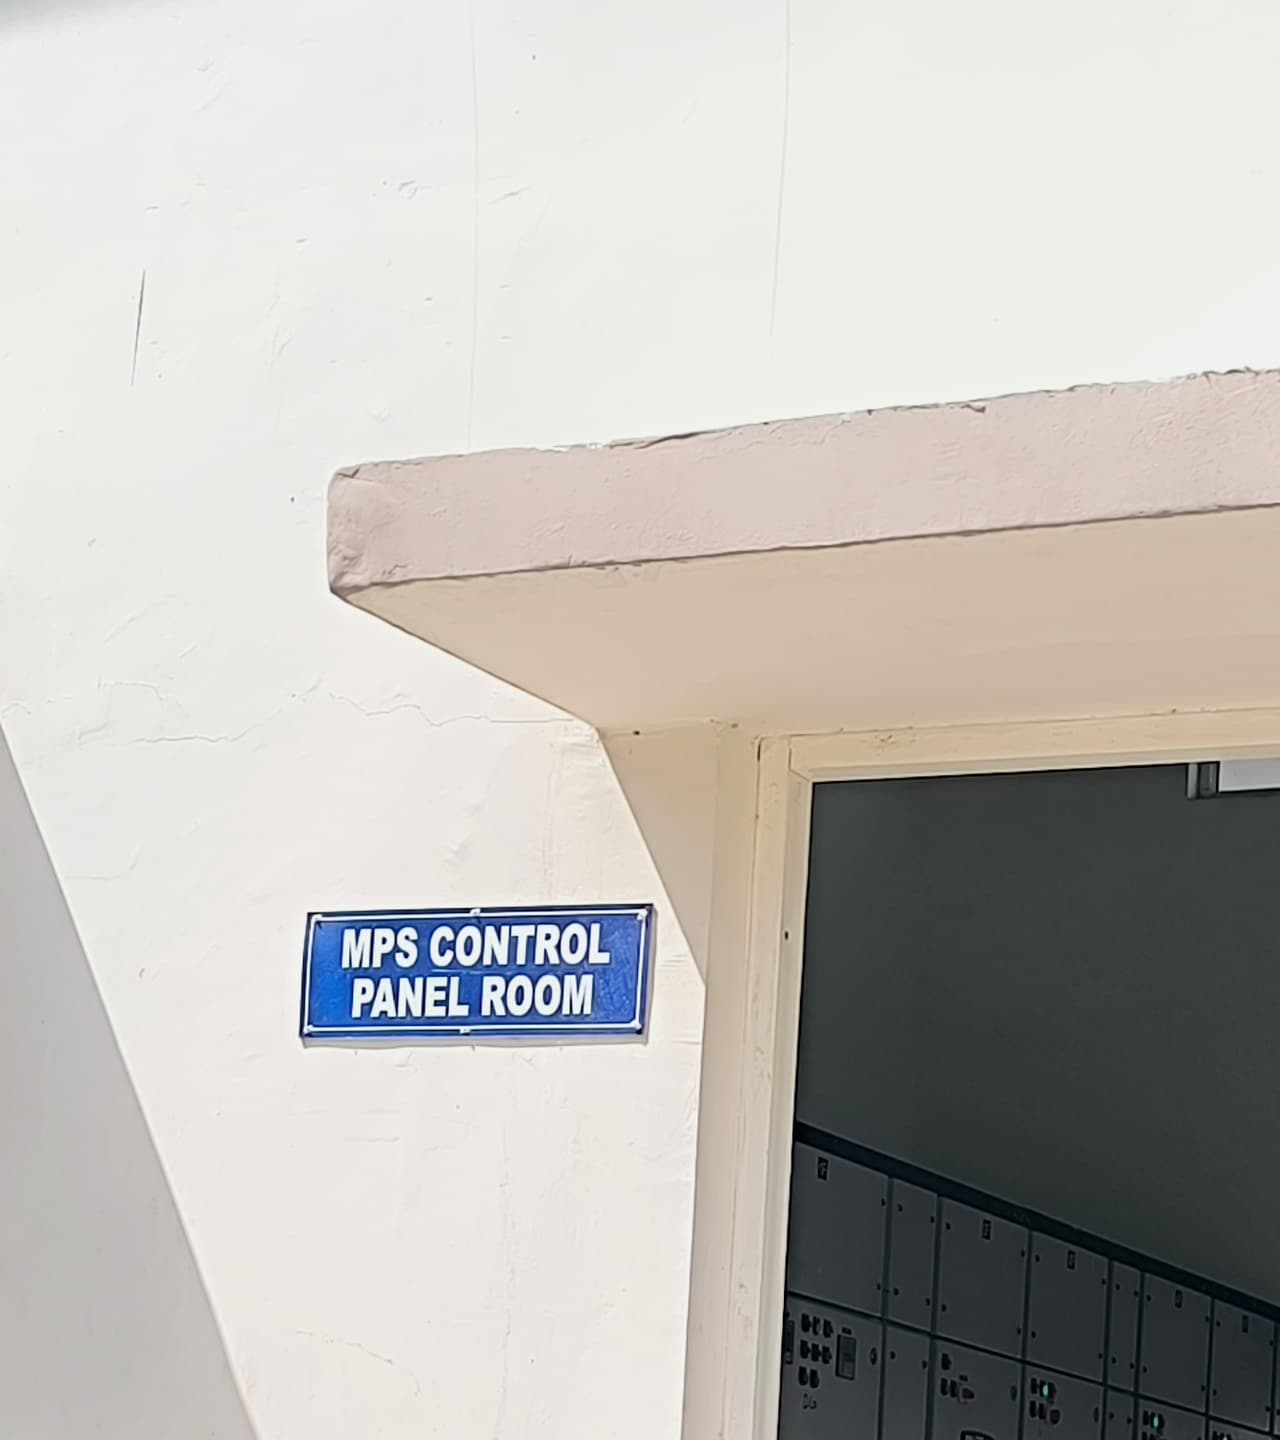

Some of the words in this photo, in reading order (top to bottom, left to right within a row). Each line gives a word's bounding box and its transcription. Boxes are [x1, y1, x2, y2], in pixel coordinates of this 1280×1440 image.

[341, 925, 418, 969] MPS
[429, 923, 610, 967] CONTROL
[351, 976, 469, 1018] PANEL
[481, 974, 593, 1016] ROOM
